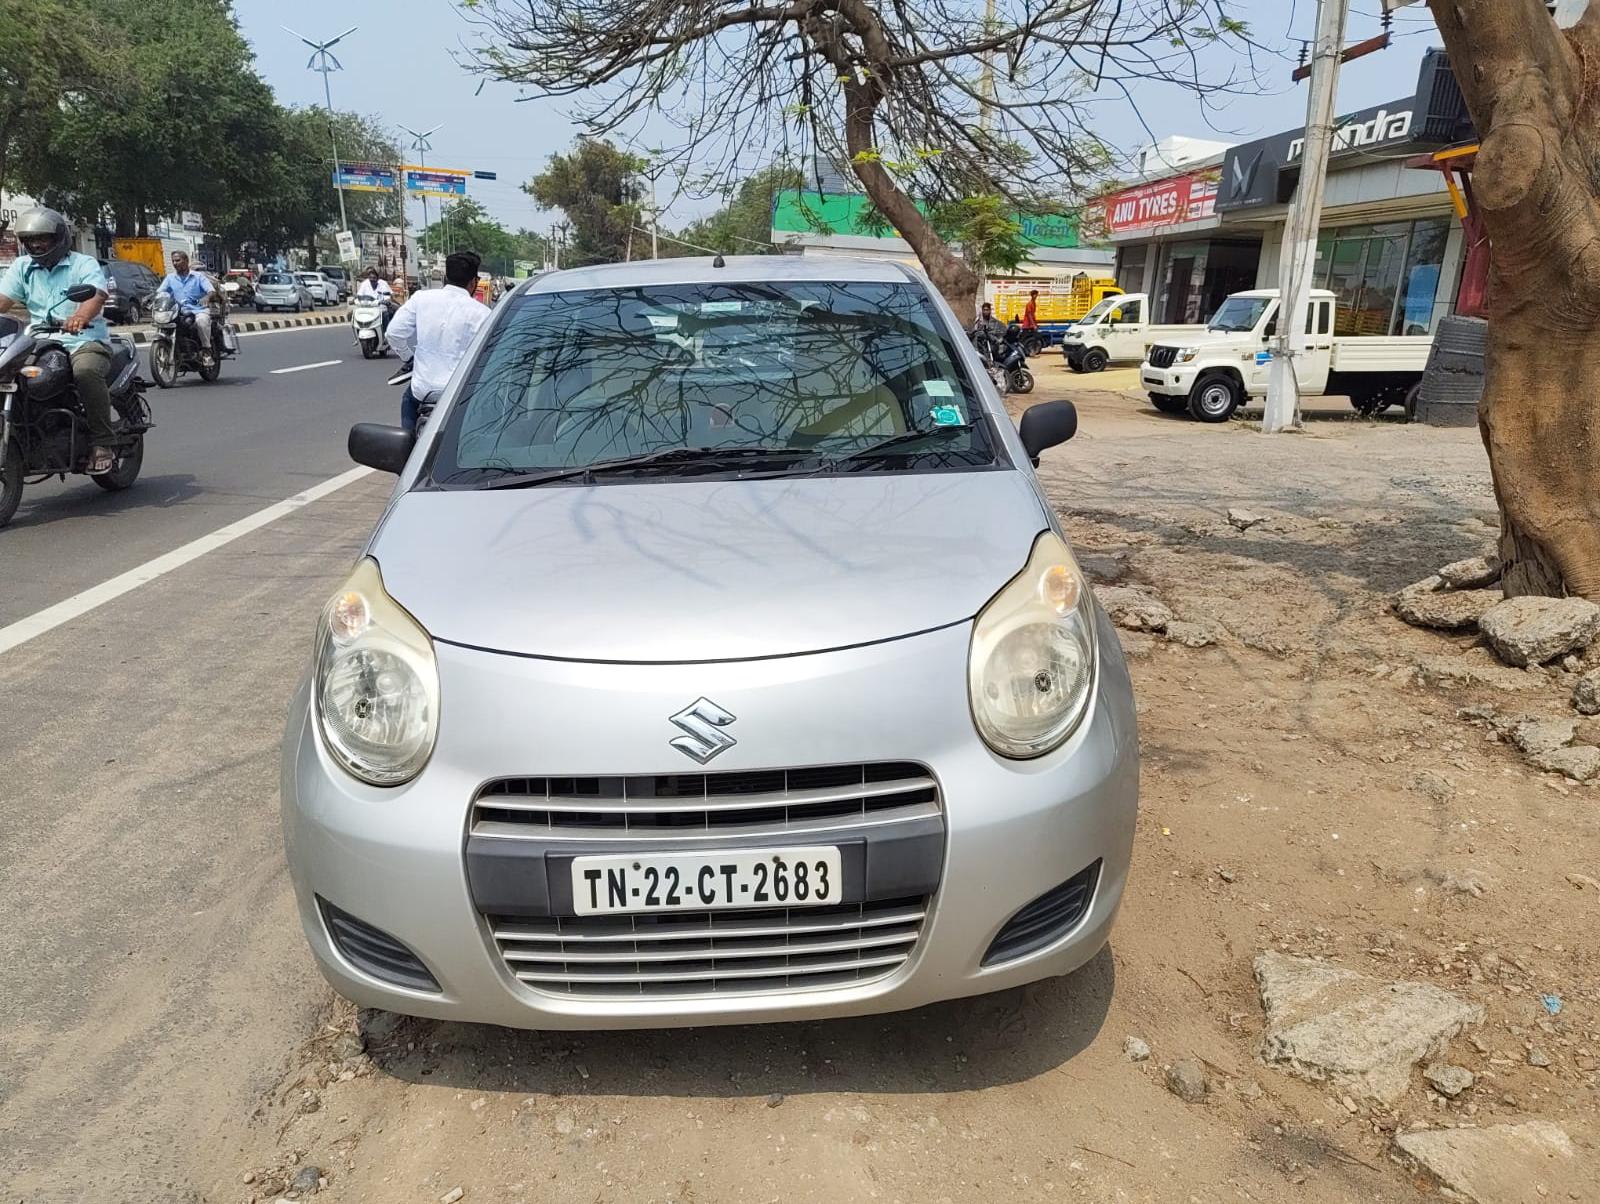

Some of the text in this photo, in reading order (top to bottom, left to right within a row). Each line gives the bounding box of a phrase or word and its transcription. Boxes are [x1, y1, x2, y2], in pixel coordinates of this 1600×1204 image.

[1112, 200, 1136, 224] ANU
[1139, 191, 1178, 220] TYRES
[584, 860, 830, 909] TN-22-CT-2683
